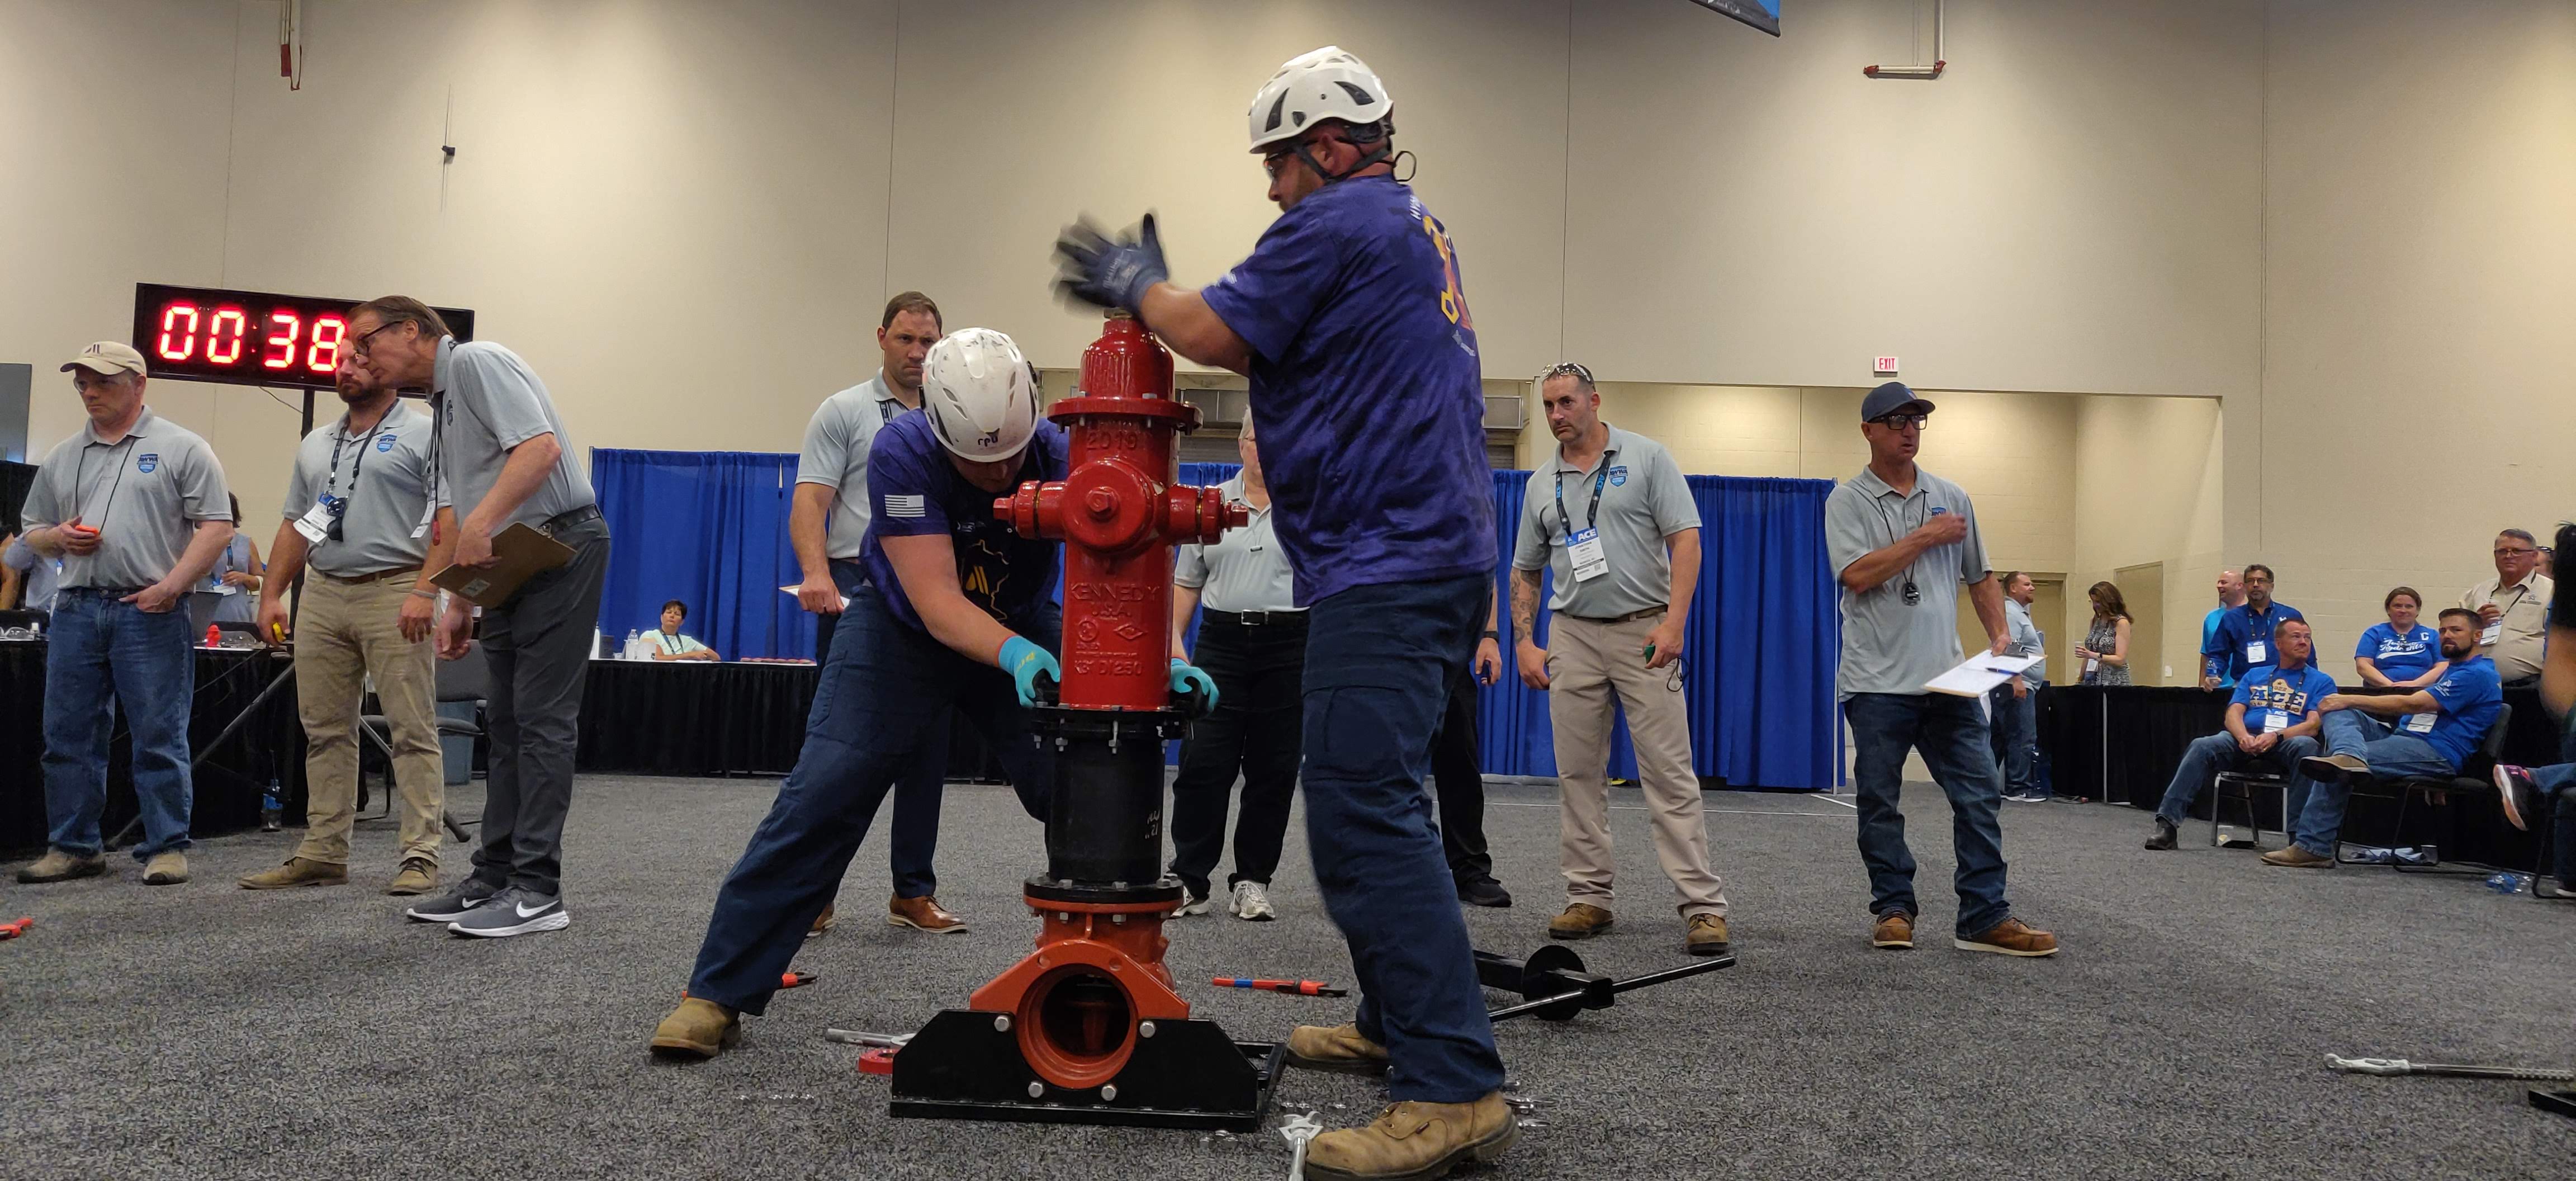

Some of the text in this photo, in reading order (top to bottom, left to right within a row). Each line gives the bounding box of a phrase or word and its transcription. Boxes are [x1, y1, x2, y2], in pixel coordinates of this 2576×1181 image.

[1879, 357, 1896, 370] EXIT
[1578, 528, 1597, 542] ACE
[1071, 583, 1161, 601] KENNEDY
[2250, 689, 2304, 707] ACE
